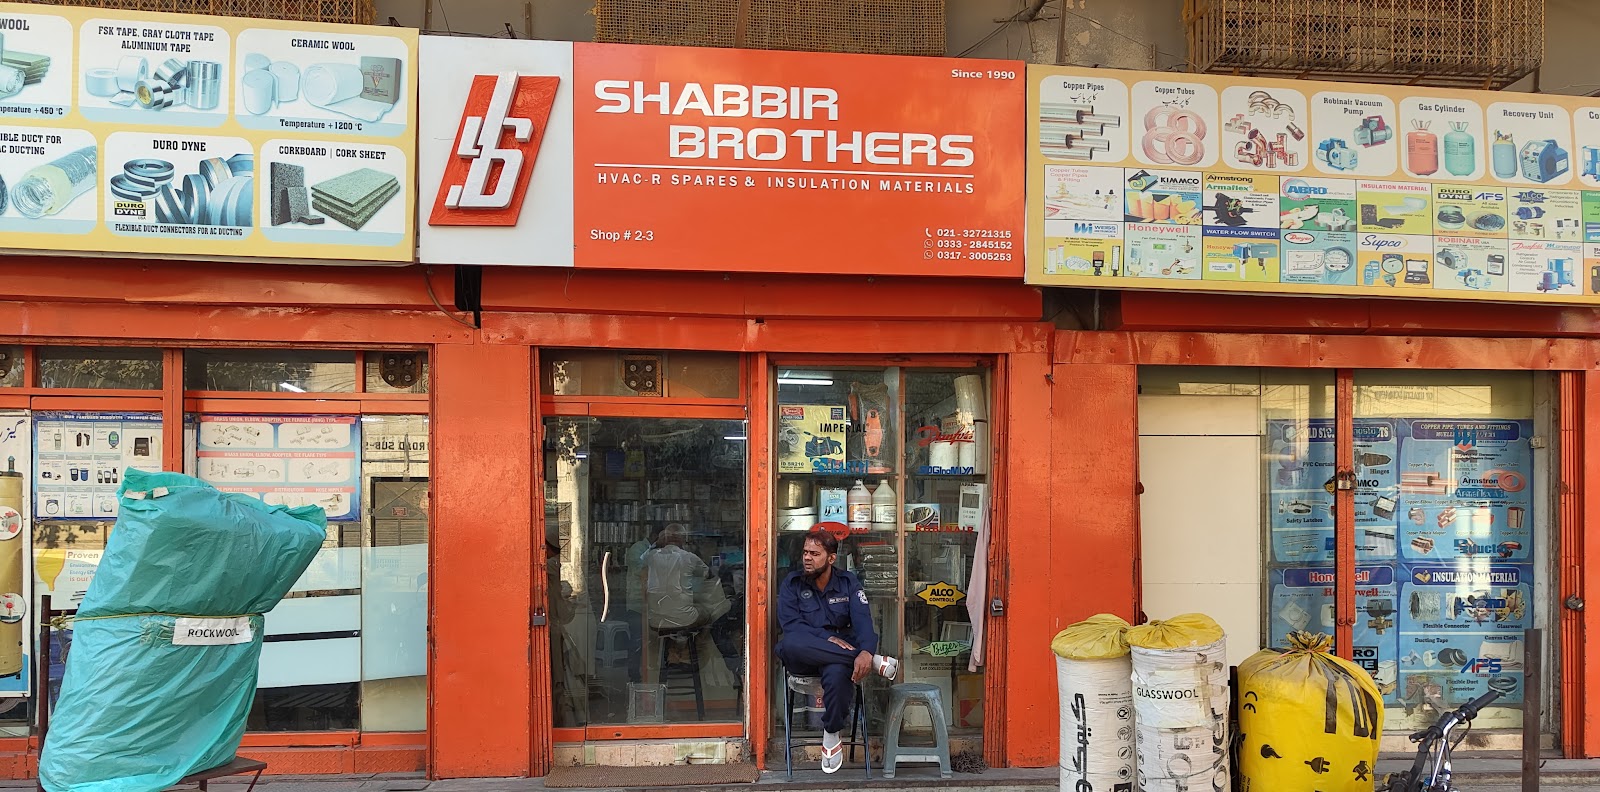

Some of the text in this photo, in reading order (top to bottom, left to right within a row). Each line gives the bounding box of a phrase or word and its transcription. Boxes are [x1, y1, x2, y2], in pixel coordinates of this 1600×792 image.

[0, 19, 30, 31] WOOL
[98, 26, 114, 36] FSK
[142, 29, 163, 39] GRAY
[165, 30, 191, 41] CLOTH
[193, 32, 214, 42] TAPE
[121, 40, 191, 52] ALUMINIUM TAPE
[291, 38, 355, 51] CERAMIC WOOL
[951, 69, 1016, 80] Since 1990
[1063, 81, 1105, 92] Copper Pipes
[1154, 86, 1195, 95] Copper Tubes
[594, 80, 839, 121] SHABBIR
[1323, 97, 1383, 107] Robinair Vacuum
[34, 106, 54, 115] +450
[1343, 107, 1364, 116] Pump
[1418, 103, 1465, 113] Gas Cylinder
[1503, 109, 1554, 119] Recovery Unit
[280, 118, 325, 129] Temperature
[22, 134, 43, 143] DUCT
[46, 135, 62, 144] FOR
[0, 145, 45, 155] C DUCTING
[153, 140, 206, 152] DURO DYNE
[669, 125, 975, 168] BROTHERS
[279, 146, 386, 160] CORKBOARD CORK SHEET
[598, 172, 975, 194] HVAC-R SPARES & INSULATION MATERIALS
[1160, 177, 1200, 185] KIMMCO
[1206, 174, 1253, 183] Armstrong
[1475, 192, 1504, 201] AFS
[116, 208, 144, 216] DYNE
[115, 223, 243, 236] FLEXIBLE DUCT CONNECTORS FOR AC DUCTING
[1128, 223, 1189, 234] Honeywell
[590, 229, 654, 243] Shop # 2-3
[1289, 233, 1312, 242] Dwyer
[1438, 237, 1480, 245] ROBINAIR
[937, 240, 963, 248] 0333
[969, 240, 1012, 250] 2845152
[1361, 234, 1402, 251] Supco
[937, 251, 961, 260] 0317
[968, 252, 1012, 261] 3005253
[820, 423, 867, 433] IMPERIAL
[67, 551, 99, 560] Proven
[929, 588, 954, 597] ALCO
[187, 628, 240, 638] ROCKWOOL
[1460, 657, 1502, 674] AFS
[1136, 687, 1200, 701] GLASSWOOL
